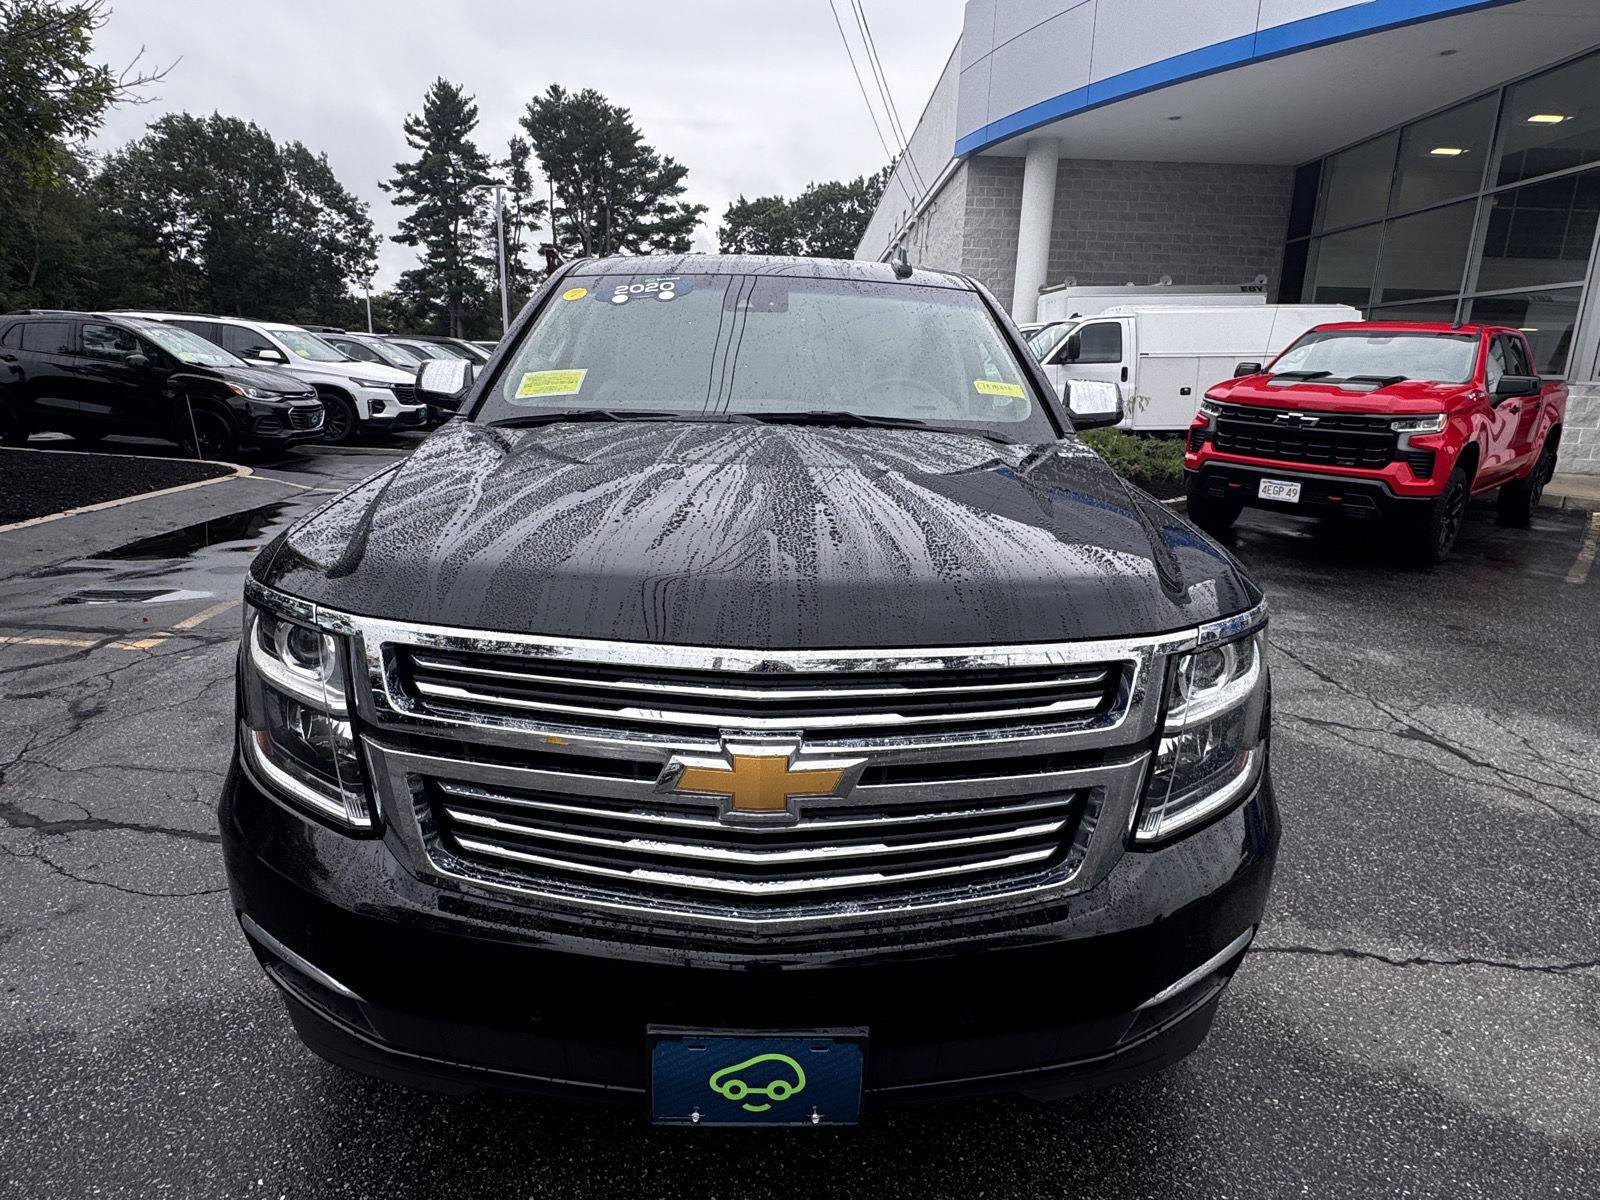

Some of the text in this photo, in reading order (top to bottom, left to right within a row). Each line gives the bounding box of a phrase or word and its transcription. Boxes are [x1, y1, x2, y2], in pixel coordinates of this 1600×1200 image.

[613, 281, 675, 295] 2020
[1261, 484, 1285, 496] 4EGP
[1285, 487, 1298, 498] 49
